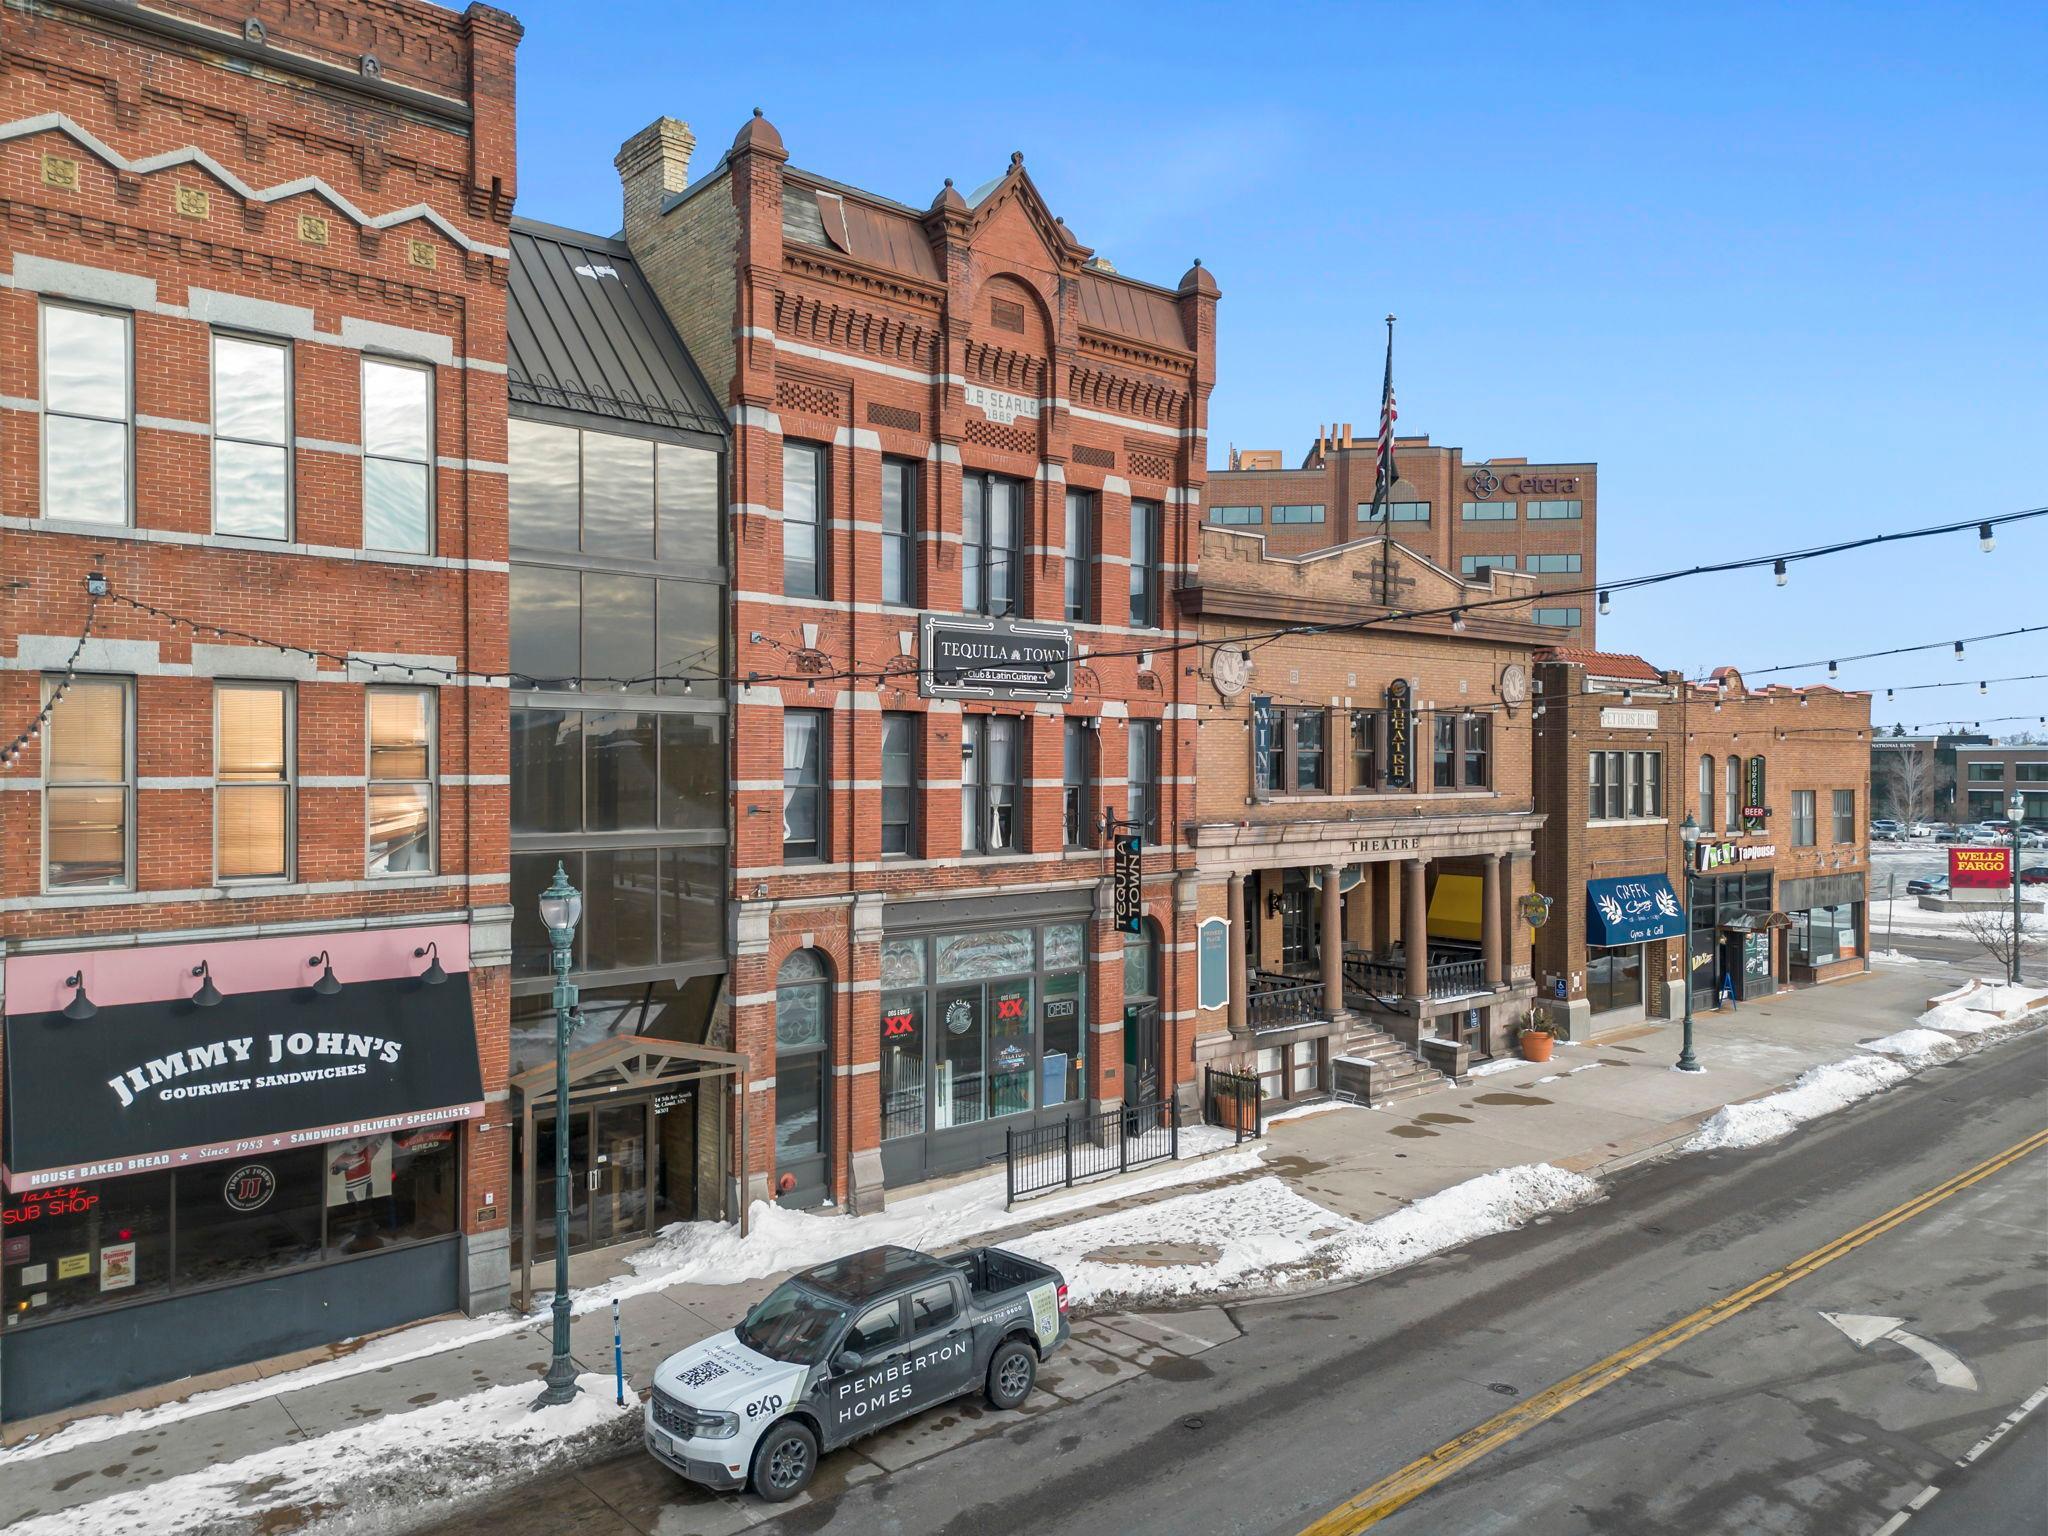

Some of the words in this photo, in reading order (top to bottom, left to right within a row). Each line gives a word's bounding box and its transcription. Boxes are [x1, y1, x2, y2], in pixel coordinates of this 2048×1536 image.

[988, 409, 1012, 423] 1886
[1502, 474, 1576, 495] Cetera
[942, 642, 1008, 660] TEQUILA
[1024, 648, 1066, 662] TOWN
[968, 670, 984, 679] Club
[992, 672, 1012, 681] Latin
[1012, 672, 1038, 681] Cuisine
[1392, 698, 1406, 777] THEATRE
[1744, 808, 1764, 816] BEER
[1349, 839, 1419, 852] THEATRE
[1956, 852, 2005, 861] WELLS
[1957, 862, 2005, 871] FARGO
[1116, 841, 1126, 929] TEQUILA
[1129, 854, 1140, 917] TOWN
[946, 1003, 956, 1024] WHITE
[998, 998, 1024, 1019] XX
[1049, 1001, 1073, 1017] OPEN
[883, 1014, 913, 1036] XX
[107, 1037, 253, 1107] JIMMY
[268, 1032, 402, 1063] JOHN'S
[159, 1079, 252, 1101] GOURMET
[255, 1063, 367, 1089] SANDWICHES
[31, 1168, 76, 1186] HOUSE
[80, 1161, 123, 1178] BAKED
[127, 1154, 171, 1171] BREAD
[199, 1147, 230, 1159] Since
[235, 1139, 264, 1152] 1983
[290, 1126, 349, 1144] SANDWICH
[353, 1117, 403, 1134] DELIVERY
[406, 1106, 471, 1125] SPECIALISTS
[414, 1141, 439, 1153] BREAD
[238, 1177, 262, 1200] JJ
[2, 1204, 42, 1225] SUB
[48, 1196, 99, 1216] SHOP
[839, 1341, 966, 1399] PEMBERTON
[839, 1384, 912, 1423] HOMES
